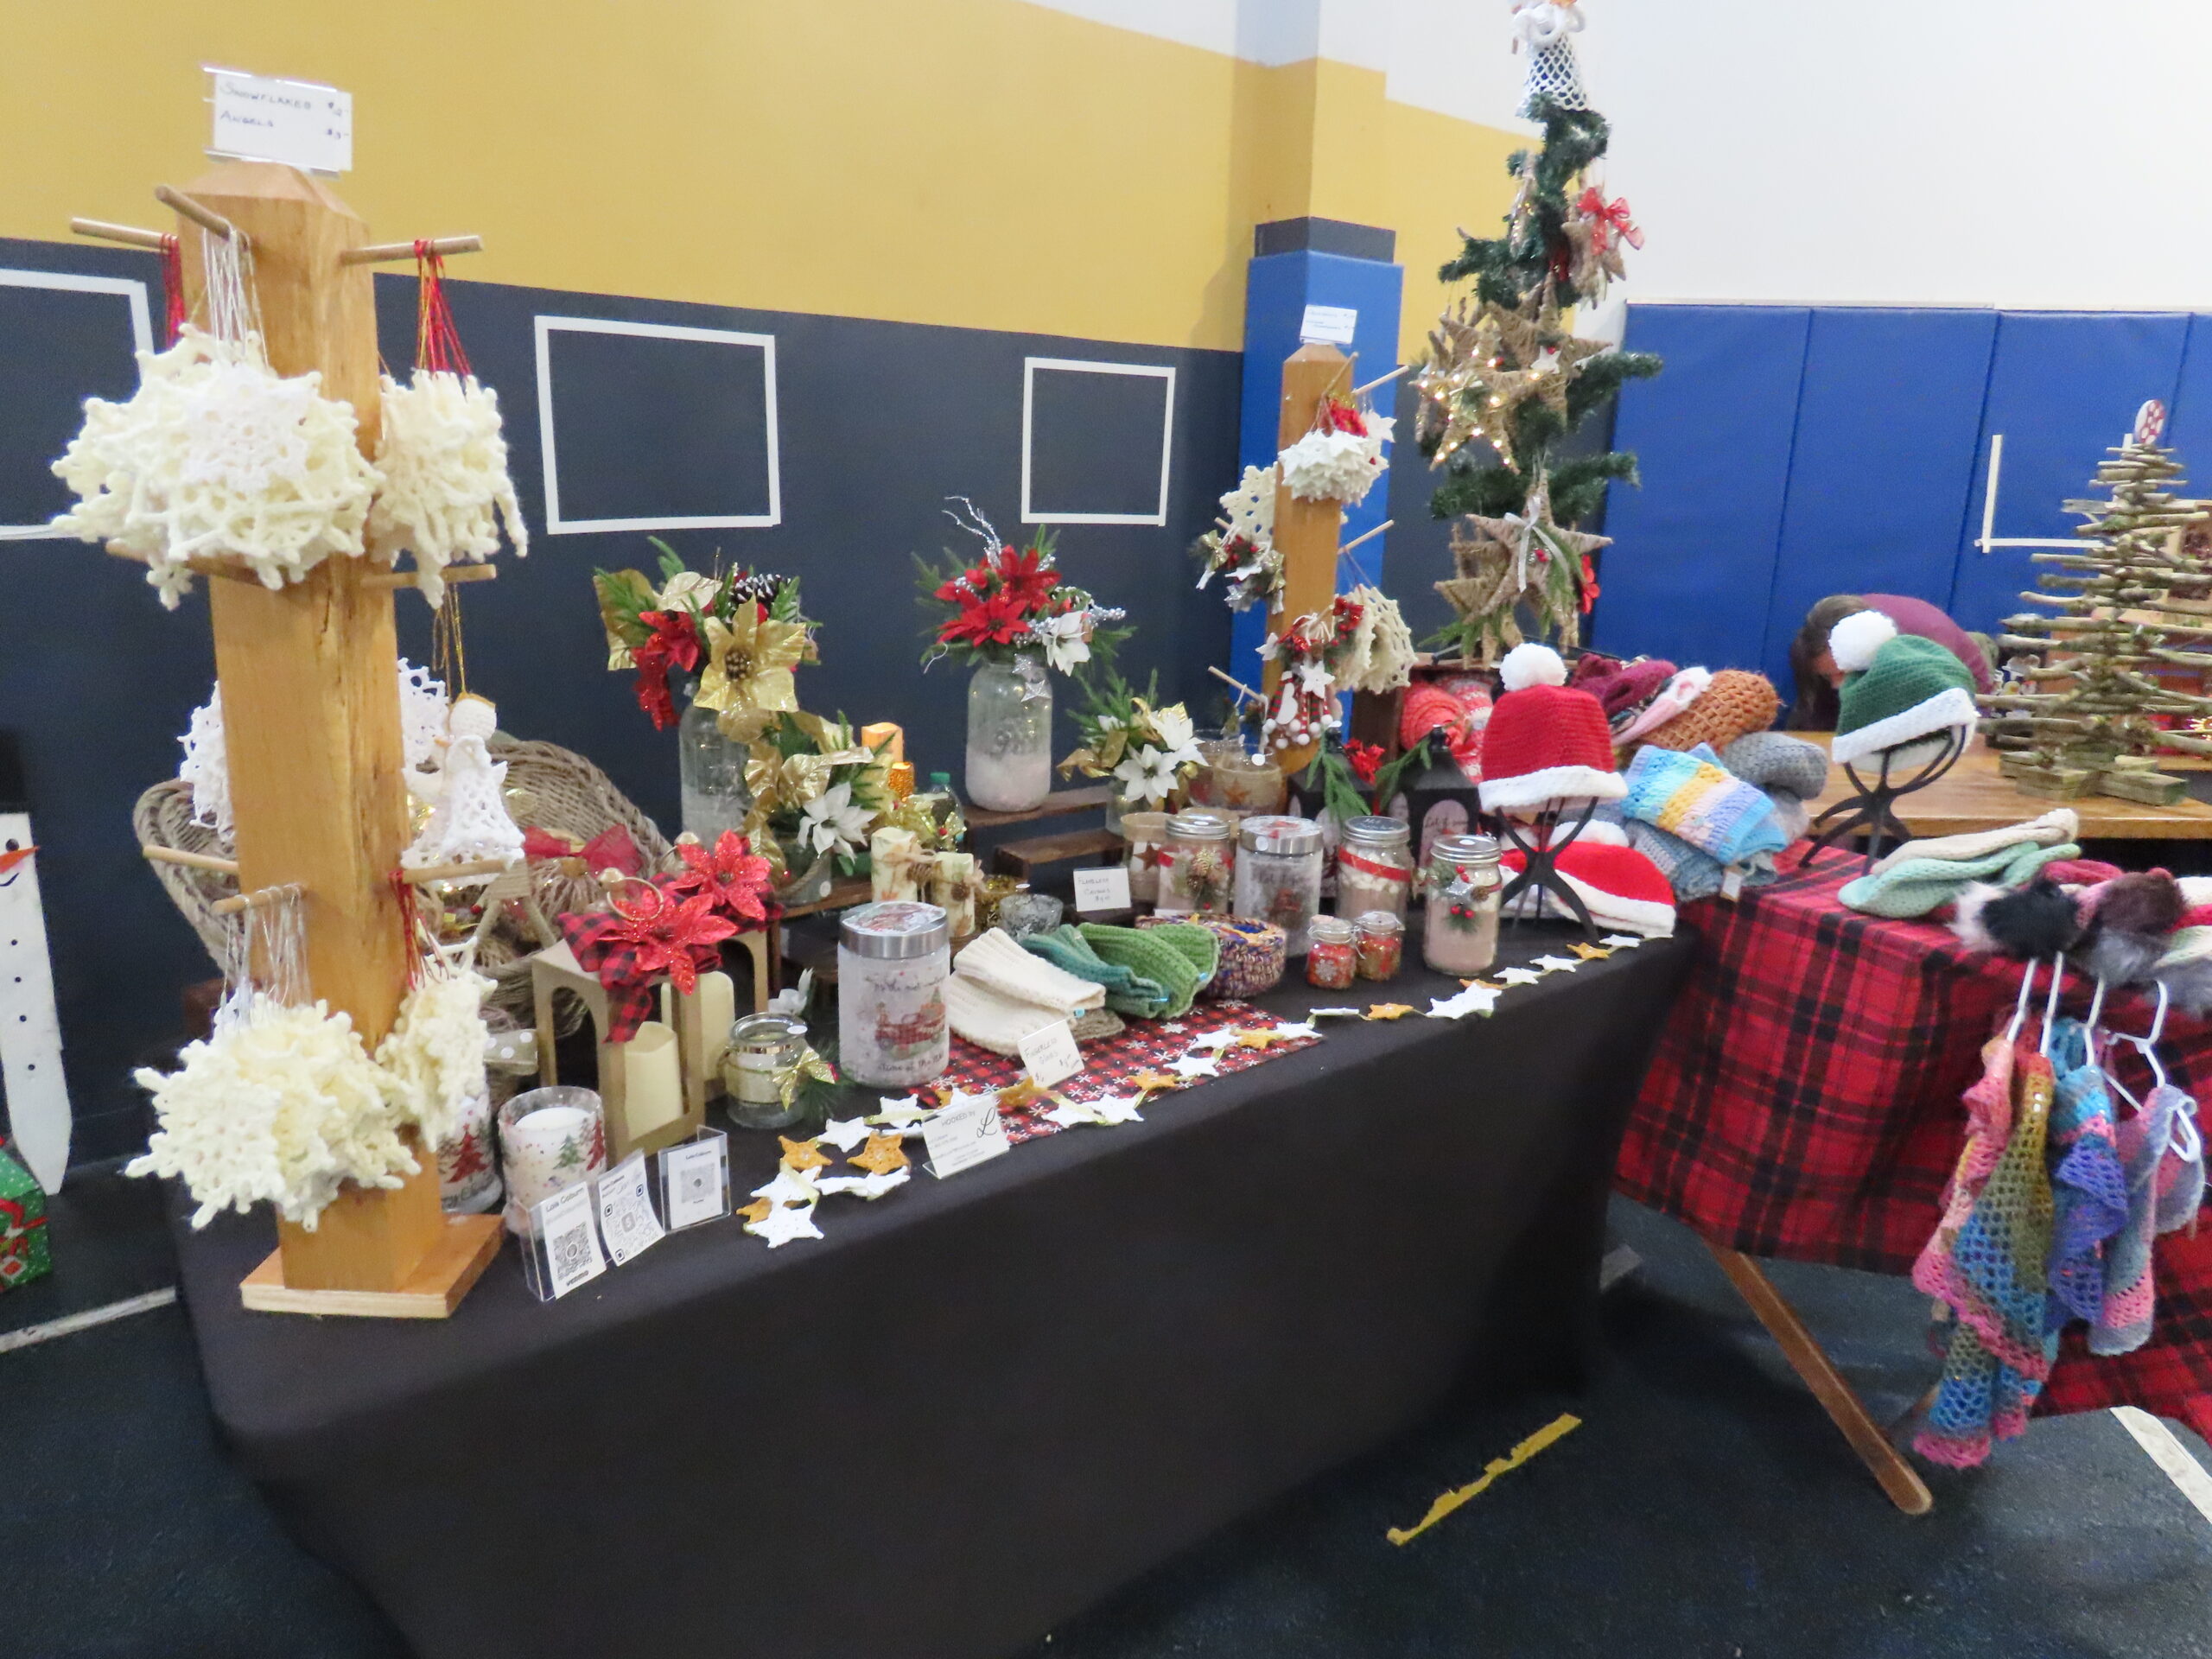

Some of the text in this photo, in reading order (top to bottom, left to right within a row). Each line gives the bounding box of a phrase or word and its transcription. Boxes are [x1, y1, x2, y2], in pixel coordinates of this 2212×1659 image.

[219, 80, 312, 110] SNOWFLAKES
[220, 110, 274, 127] ANGELS
[941, 1113, 969, 1127] HOOKED
